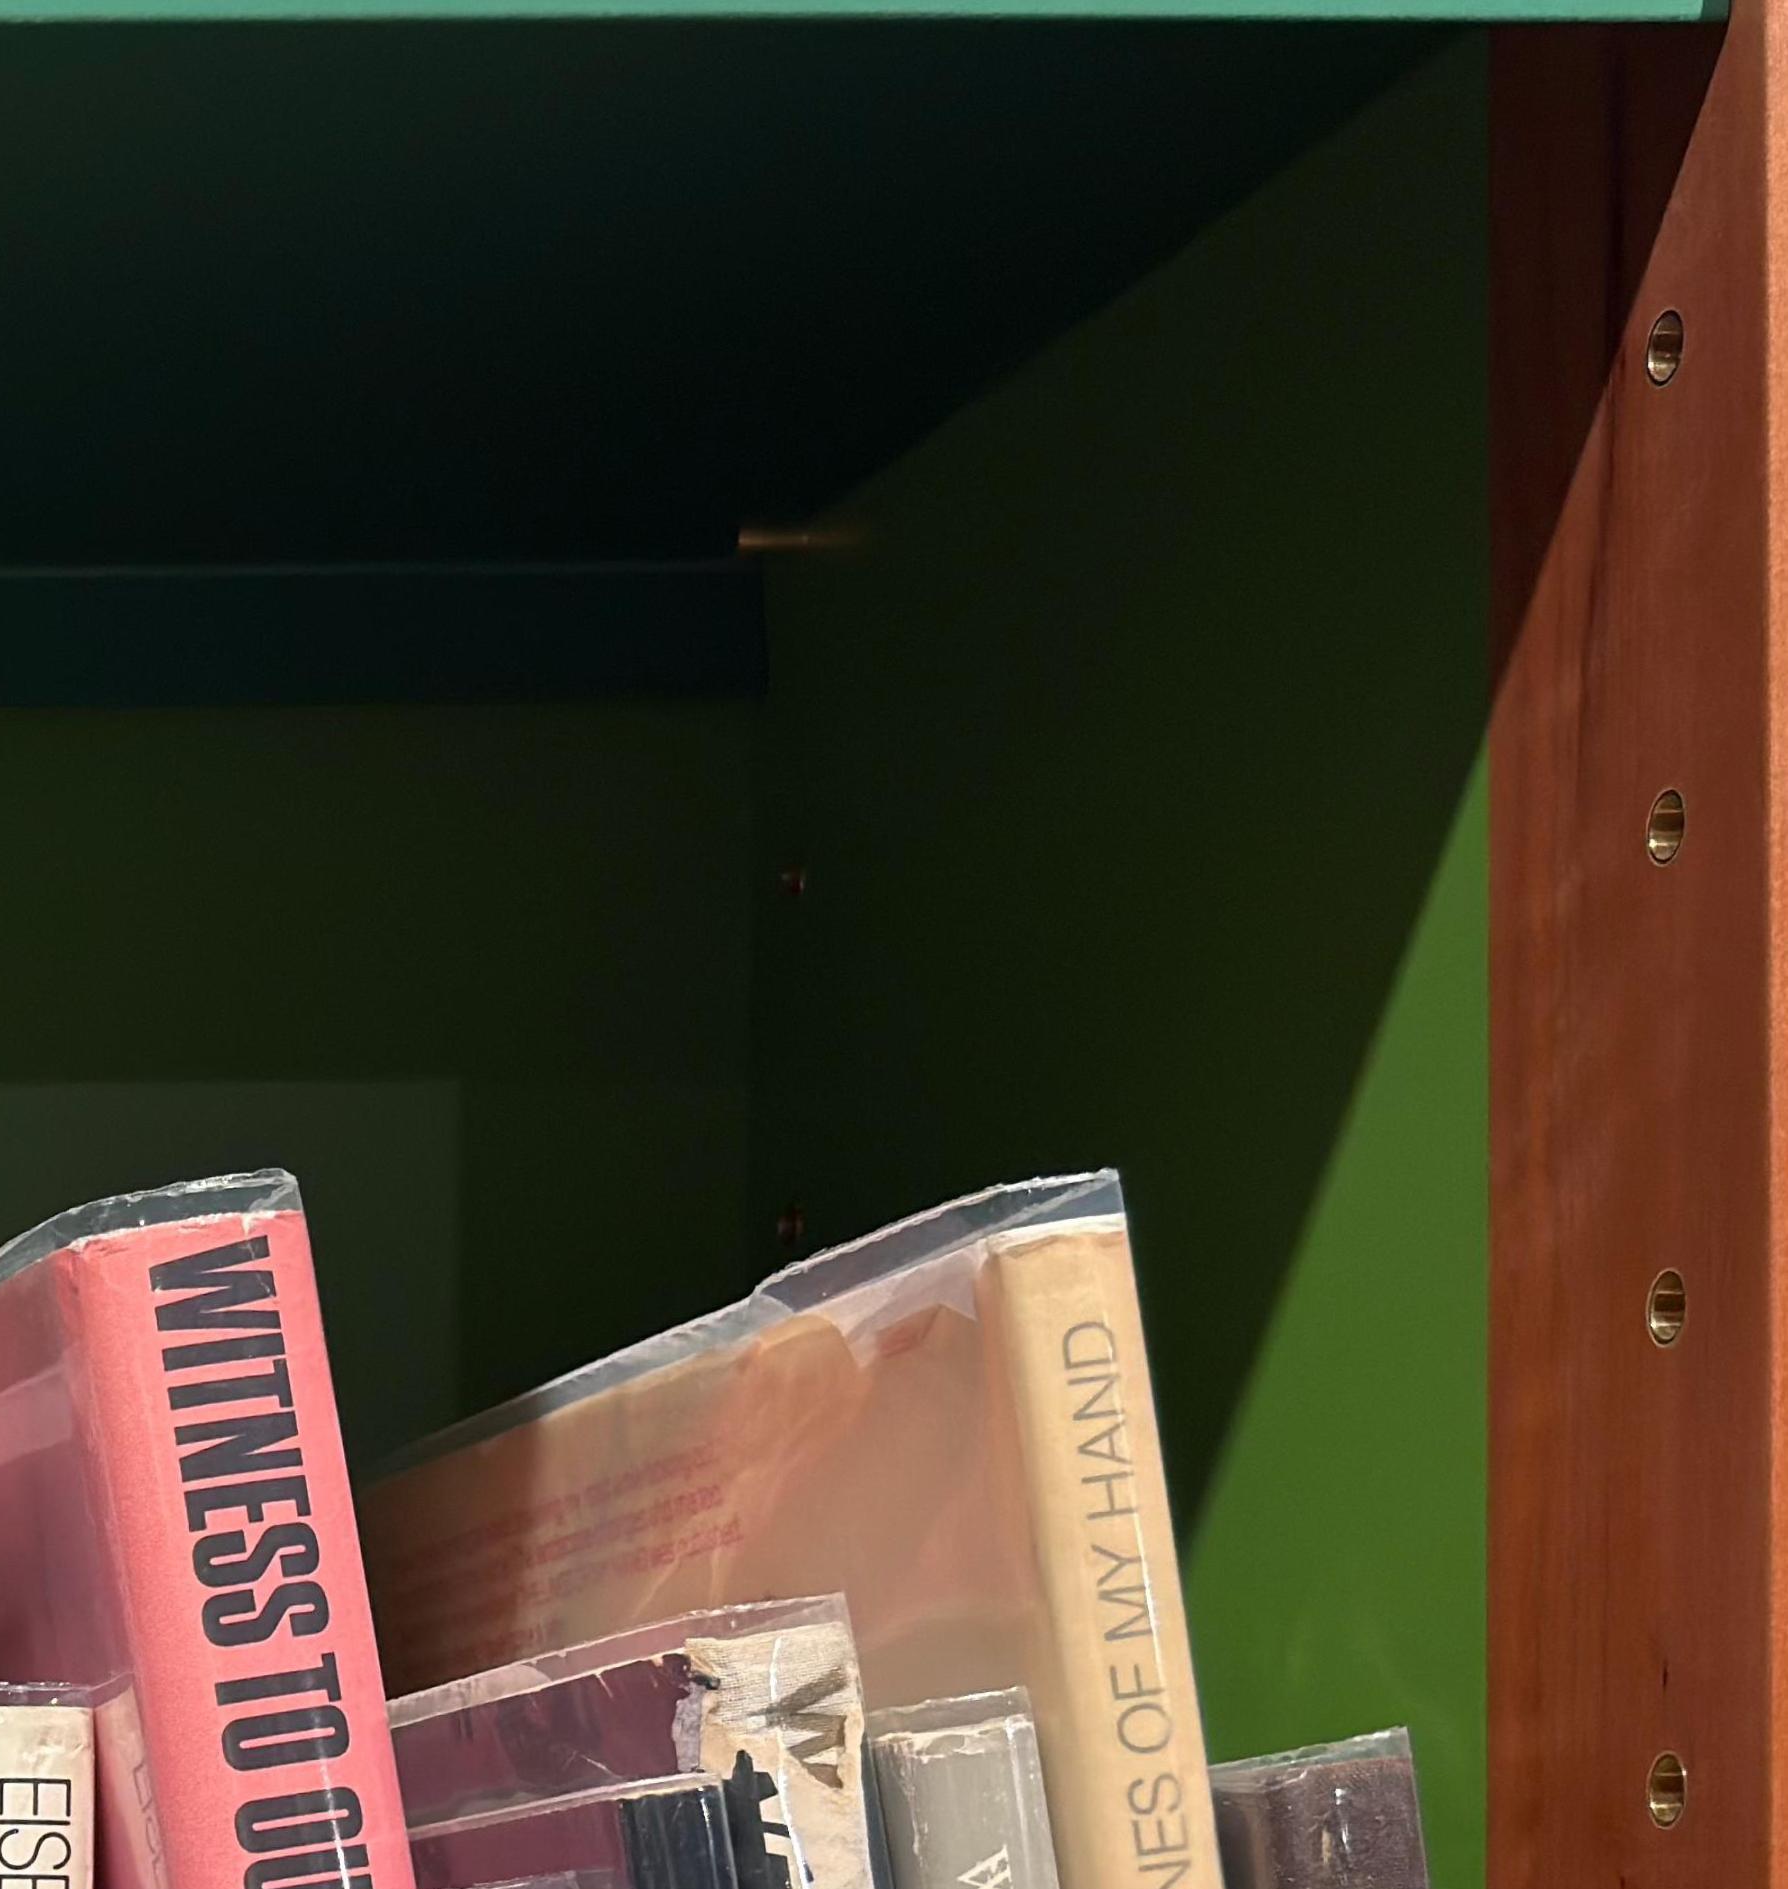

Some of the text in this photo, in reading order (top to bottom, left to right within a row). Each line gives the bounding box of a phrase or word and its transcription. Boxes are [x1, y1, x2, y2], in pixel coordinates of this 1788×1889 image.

[149, 1235, 332, 1648] WITNESS
[1060, 1320, 1132, 1519] HAND
[1093, 1545, 1150, 1644] MY
[209, 1651, 351, 1773] TO
[1111, 1665, 1170, 1756] OF
